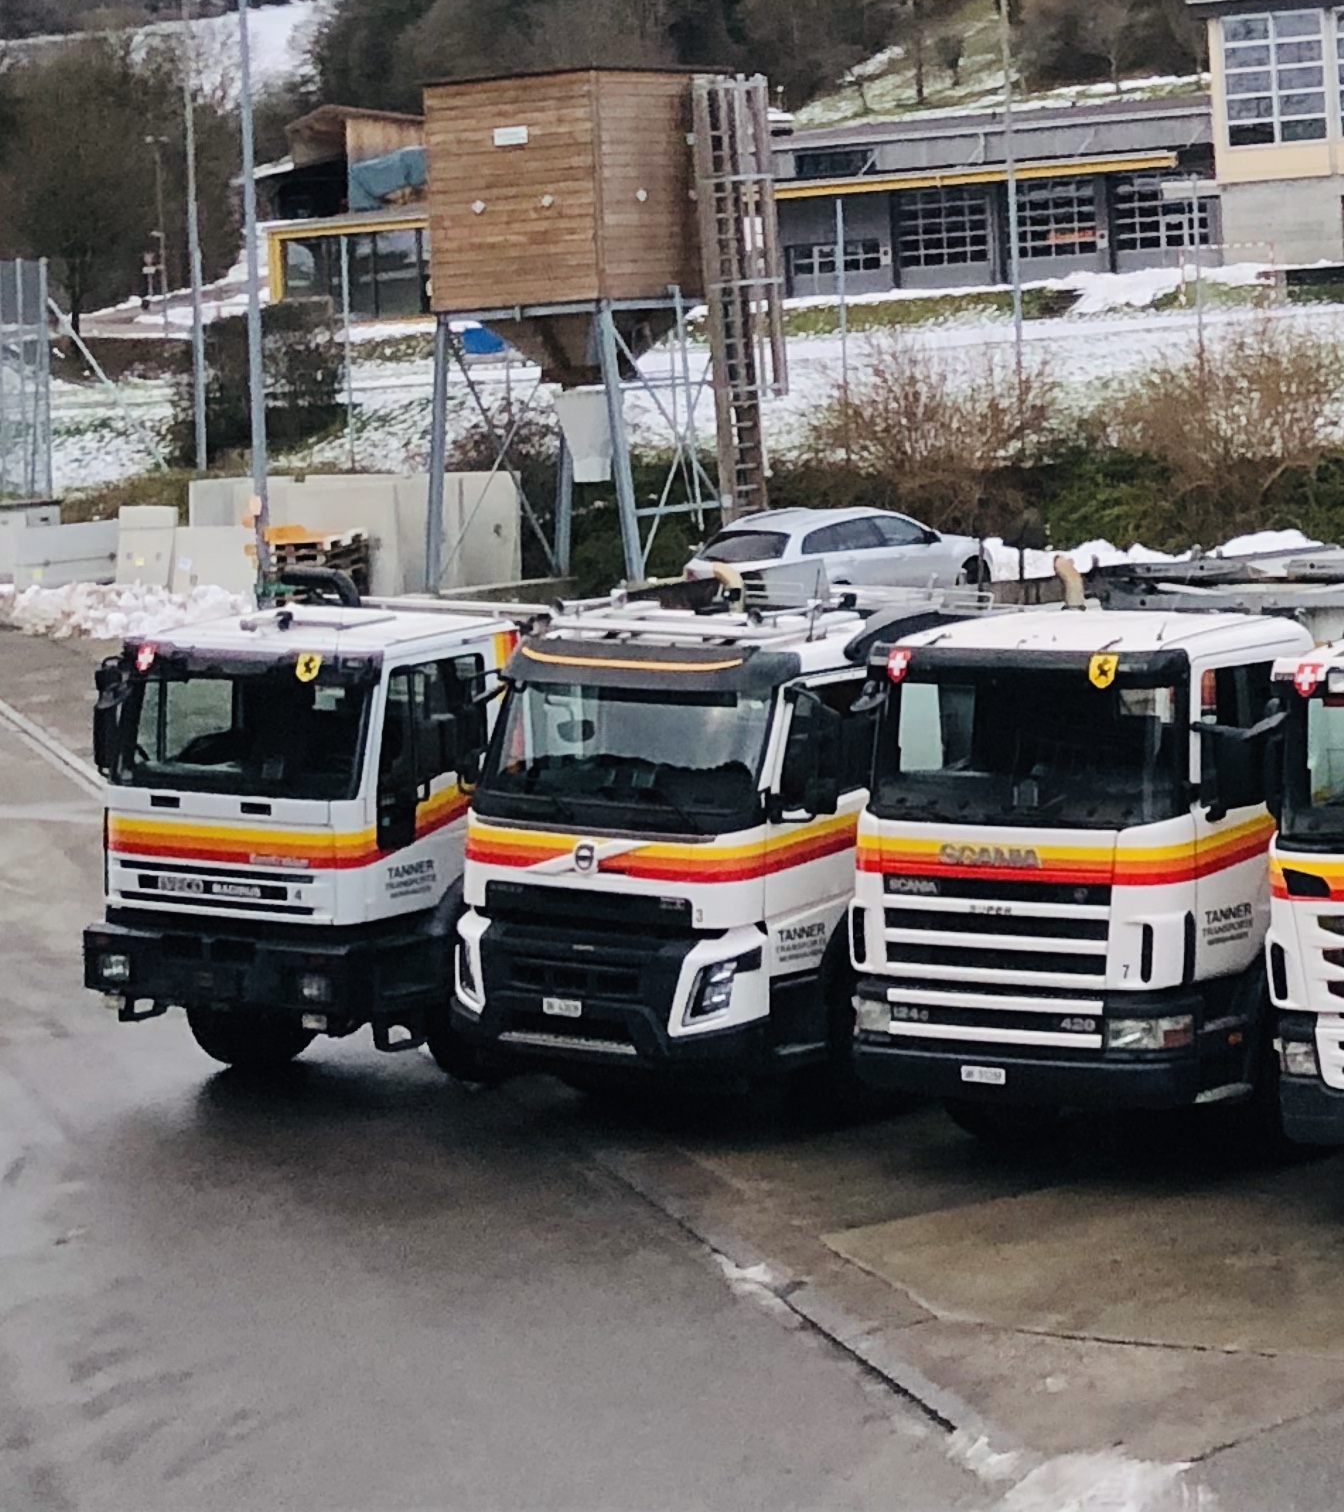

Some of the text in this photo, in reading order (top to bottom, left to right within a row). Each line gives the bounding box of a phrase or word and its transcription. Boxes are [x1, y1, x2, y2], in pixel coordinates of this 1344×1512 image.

[939, 843, 1043, 868] SCANIA
[387, 859, 434, 879] TANNER
[294, 888, 302, 901] 4
[1204, 902, 1252, 925] TANNER
[778, 922, 826, 943] TANNER
[1121, 964, 1130, 980] 7
[1060, 1017, 1096, 1033] 420
